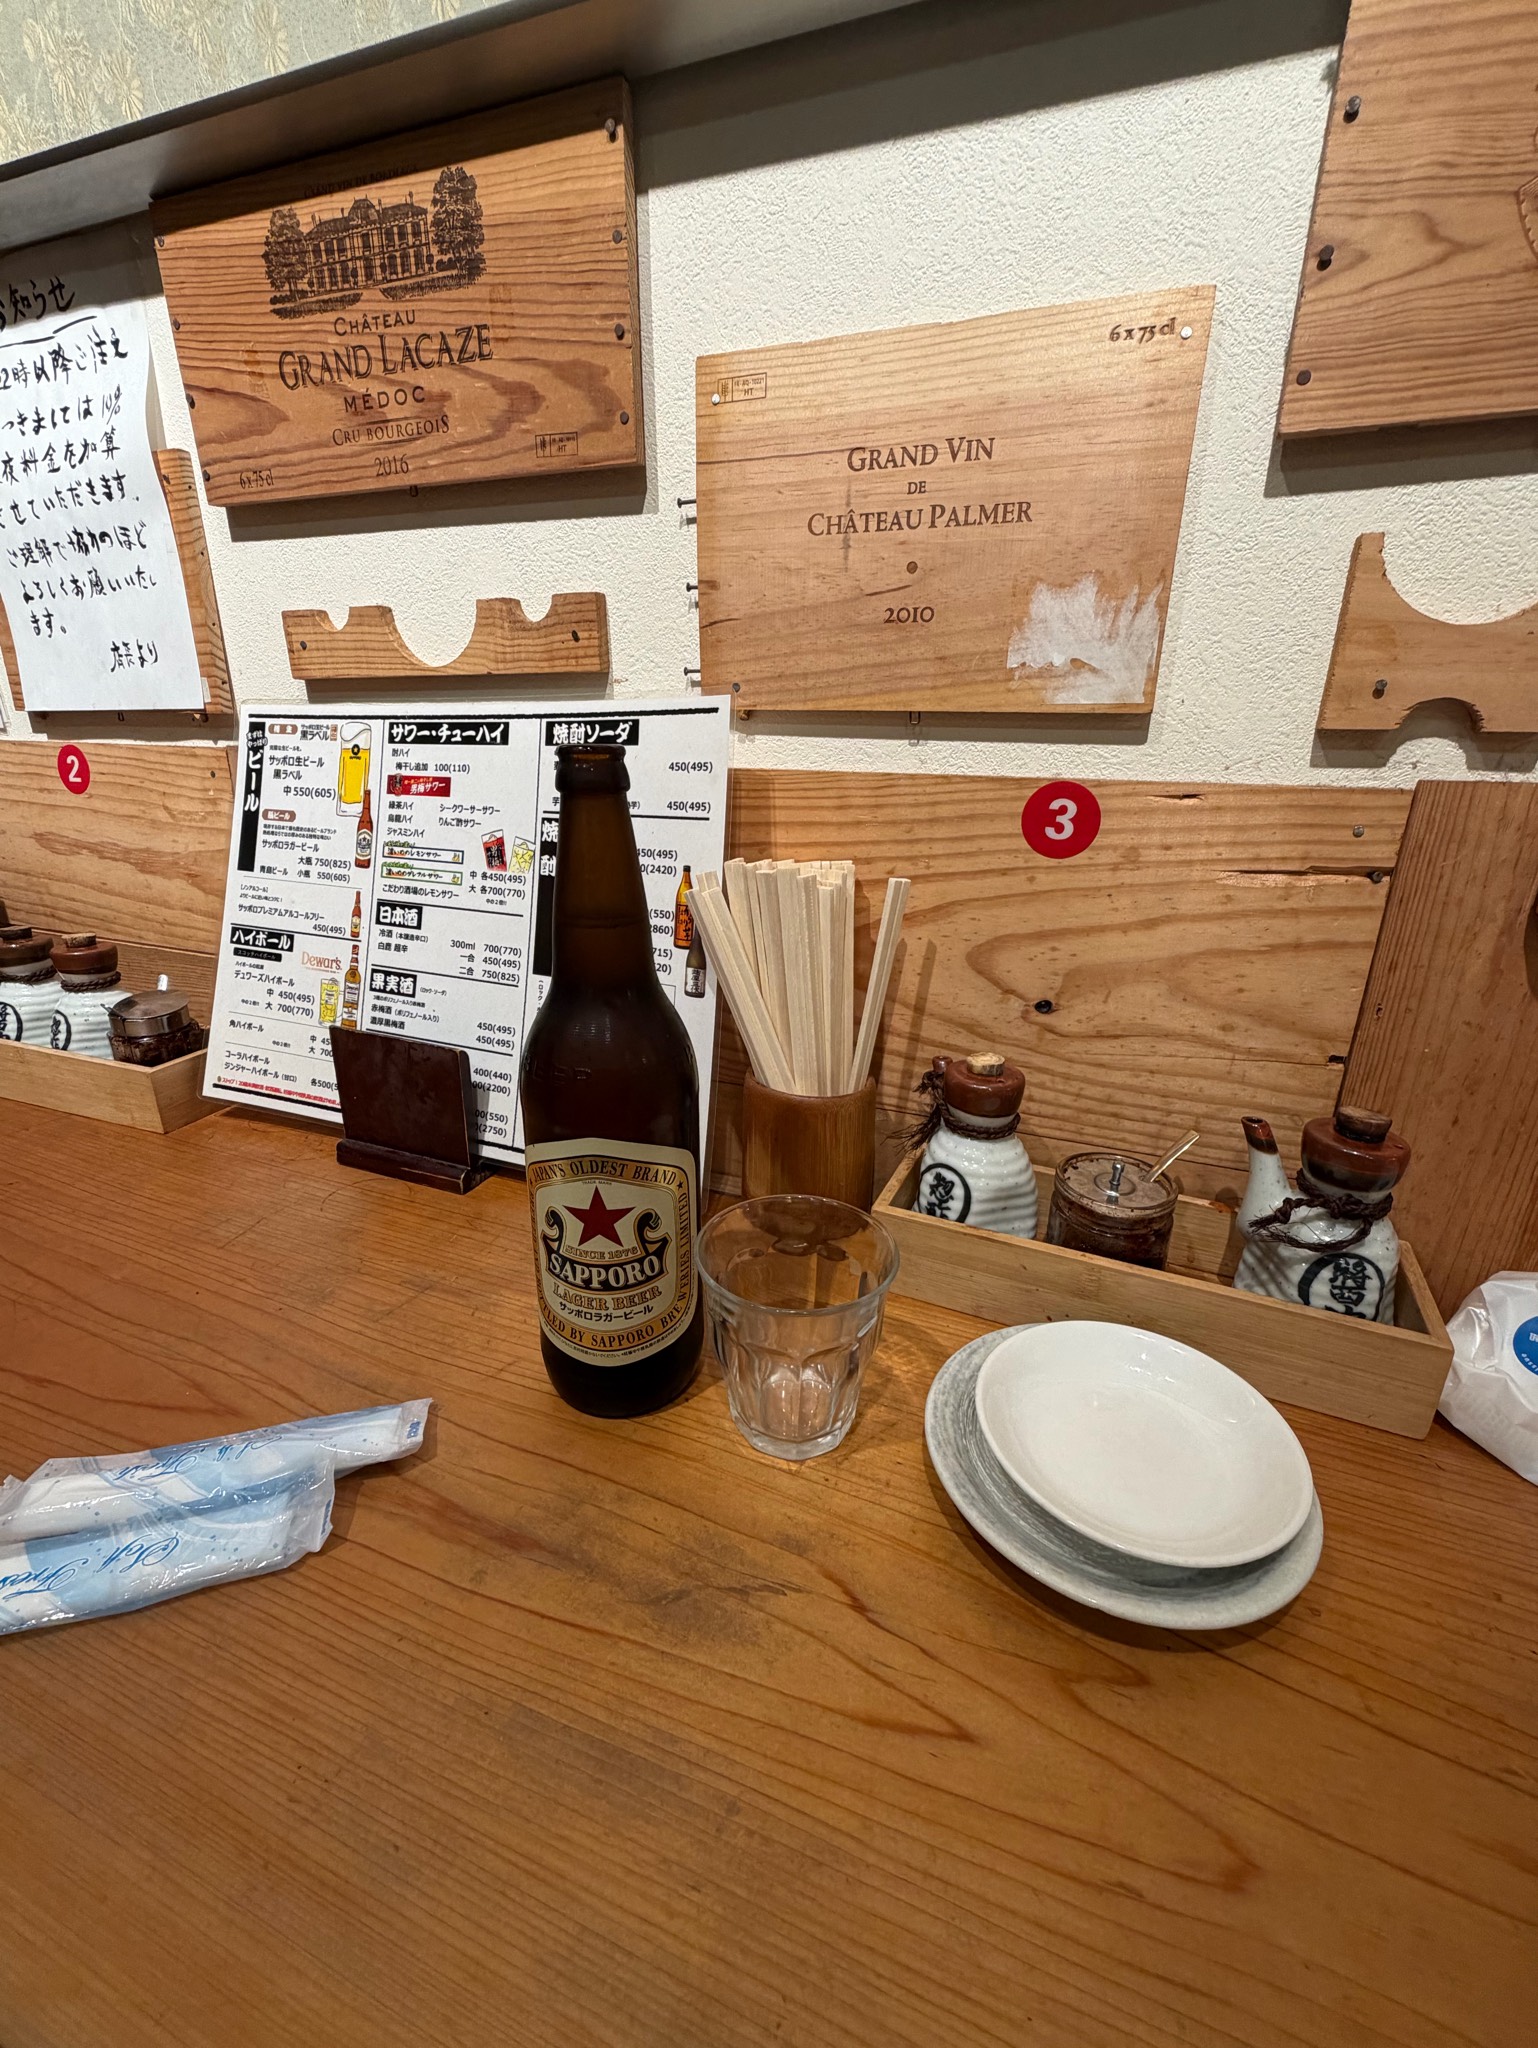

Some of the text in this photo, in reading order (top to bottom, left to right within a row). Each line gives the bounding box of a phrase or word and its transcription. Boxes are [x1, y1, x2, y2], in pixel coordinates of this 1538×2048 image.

[333, 309, 416, 337] CHÂTEAU
[0, 325, 128, 390] 2時以降ご注文
[279, 322, 496, 391] GRAND LACAZE
[344, 386, 426, 414] MÉDOC
[332, 415, 450, 447] CRU BOURGEOIS
[0, 425, 121, 485] 夜料金を加算
[847, 437, 995, 472] GRAND VIN
[375, 455, 410, 478] 2016
[907, 480, 927, 495] DE
[807, 501, 1033, 537] CHÂTEAU PALMER
[883, 606, 935, 624] 2010
[390, 723, 504, 743] サワー・チューハイ
[553, 721, 633, 744] 焼酎ソーダ
[66, 755, 82, 783] 2
[268, 755, 325, 768] サッポロ生ビール
[434, 763, 470, 774] 100(110)
[668, 761, 713, 774] 450(495)
[244, 750, 264, 812] ビール
[273, 769, 303, 780] 黒ラベル
[283, 785, 336, 800] 中 550(605)
[410, 782, 446, 795] 男梅サワー
[388, 801, 500, 814] 緑茶ハイ シークワーサーサワー
[666, 801, 711, 814] 450(495)
[438, 817, 482, 828] りんご酢サワー
[1044, 797, 1078, 841] 3
[386, 827, 425, 838] ジャスミンハイ
[262, 839, 320, 853] サッポロラガービール
[314, 857, 352, 871] 750(825)
[259, 865, 289, 876] 青島ビール
[317, 871, 351, 883] 550(605)
[470, 870, 477, 880] 中
[382, 883, 459, 899] こだわり酒場のレモンサワー
[468, 885, 477, 893] 大
[238, 904, 325, 920] サッポロプレミアムアルコールフリー
[379, 906, 418, 926] 日本酒
[312, 923, 346, 936] 450(495)
[650, 924, 674, 937] 860)
[232, 929, 291, 950] ハイボール
[450, 940, 476, 951] 300ml
[484, 944, 522, 958] 700(770)
[460, 954, 521, 970] 一合 450(495)
[655, 963, 672, 975] 20)
[234, 969, 295, 987] デュワーズハイボール
[459, 967, 520, 984] 二合 750(825)
[371, 973, 414, 995] 果実酒
[266, 988, 315, 1005] 中 450(495)
[265, 1002, 273, 1010] 大
[277, 1004, 314, 1018] 700(770)
[371, 1003, 392, 1014] 赤梅酒
[228, 1019, 264, 1032] 角ハイボール
[477, 1021, 516, 1037] 450(495)
[310, 1035, 317, 1043] 中
[476, 1035, 515, 1050] 450(495)
[225, 1050, 270, 1065] コーラハイボール
[308, 1046, 315, 1054] 大
[224, 1062, 279, 1079] ジンジャーハイボール
[473, 1067, 512, 1083] 400(440)
[532, 1160, 678, 1187] JAPAN'S OLDEST BRAND
[566, 1245, 640, 1260] SINCE 1876
[549, 1254, 661, 1290] SAPPORO
[570, 1325, 586, 1343] BY
[591, 1325, 655, 1349] SAPPORO
[660, 1249, 689, 1327] BREWERIES
[678, 1192, 689, 1247] LIMITED
[553, 1281, 663, 1312] LAGER BEER
[559, 1301, 655, 1323] サッポロラガービール
[97, 1532, 181, 1573] Soft
